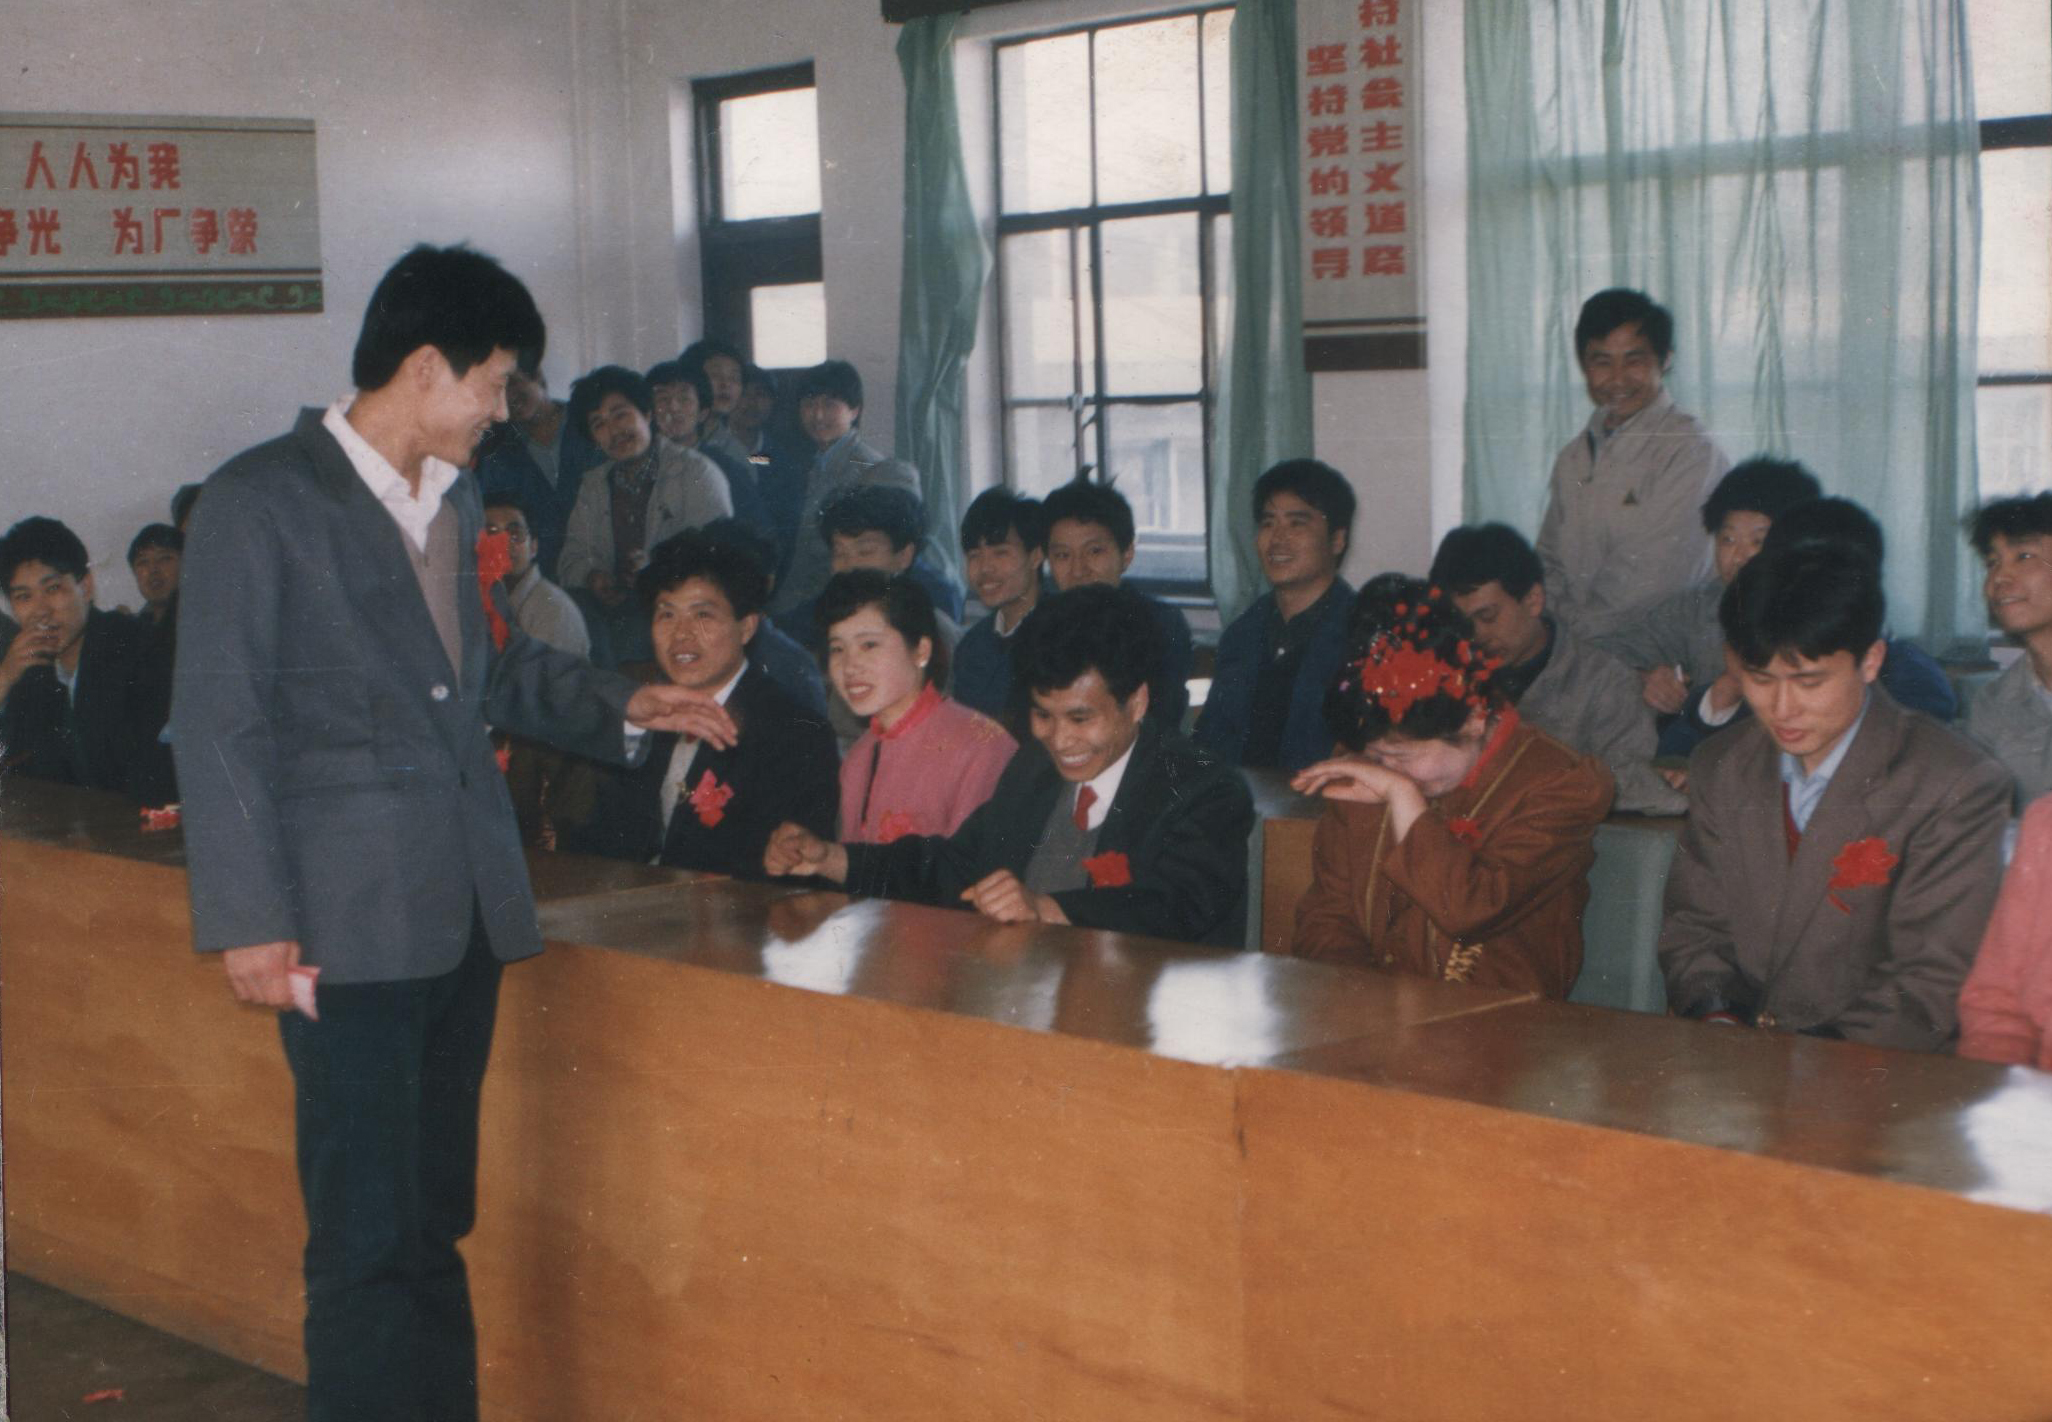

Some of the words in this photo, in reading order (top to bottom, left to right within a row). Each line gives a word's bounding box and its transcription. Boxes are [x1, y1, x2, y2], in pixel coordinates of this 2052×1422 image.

[1306, 43, 1351, 280] 坚持党的领导
